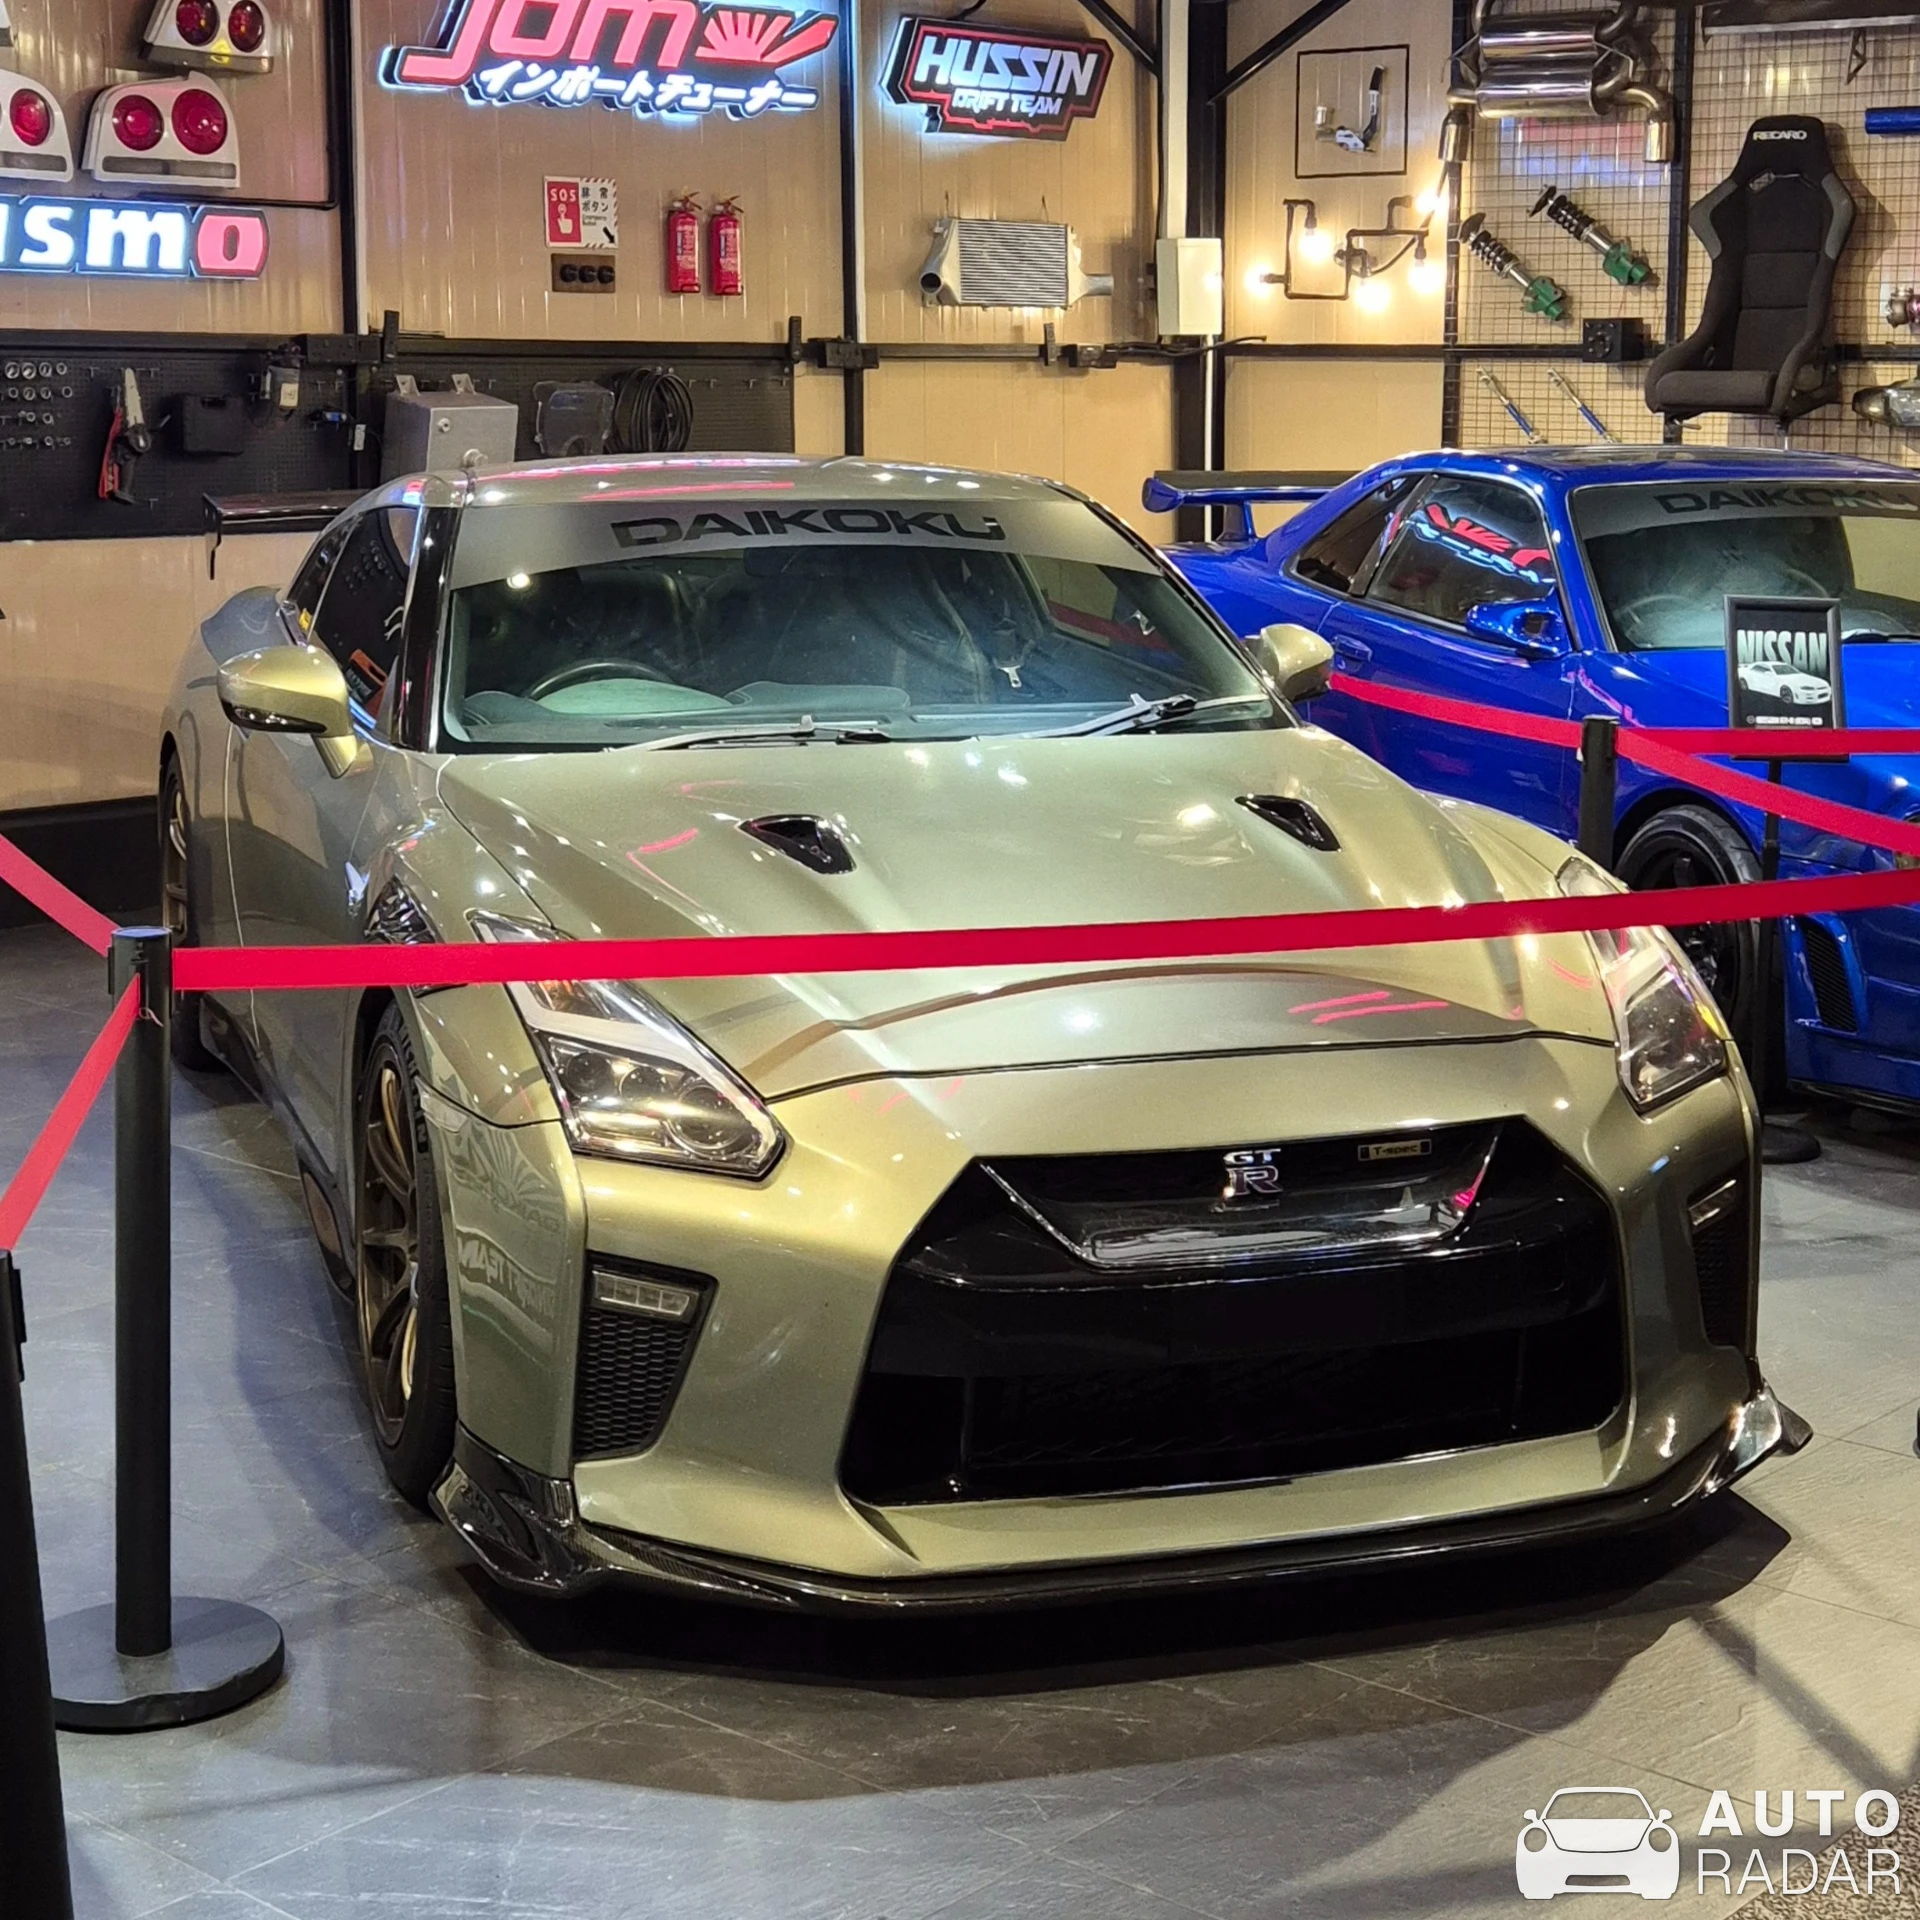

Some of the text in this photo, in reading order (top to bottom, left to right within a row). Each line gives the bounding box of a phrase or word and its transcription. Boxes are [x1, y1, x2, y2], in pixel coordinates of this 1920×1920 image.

[914, 36, 1098, 96] HUSSIN
[480, 60, 817, 113] インポートチューナー
[952, 88, 1063, 118] DRIFT TEAM
[1753, 130, 1808, 140] RECARO
[550, 188, 577, 202] SOS
[610, 508, 1006, 549] DAIKOKU
[1737, 629, 1827, 672] NISSAN
[1223, 1148, 1281, 1165] GT
[1226, 1165, 1283, 1196] R
